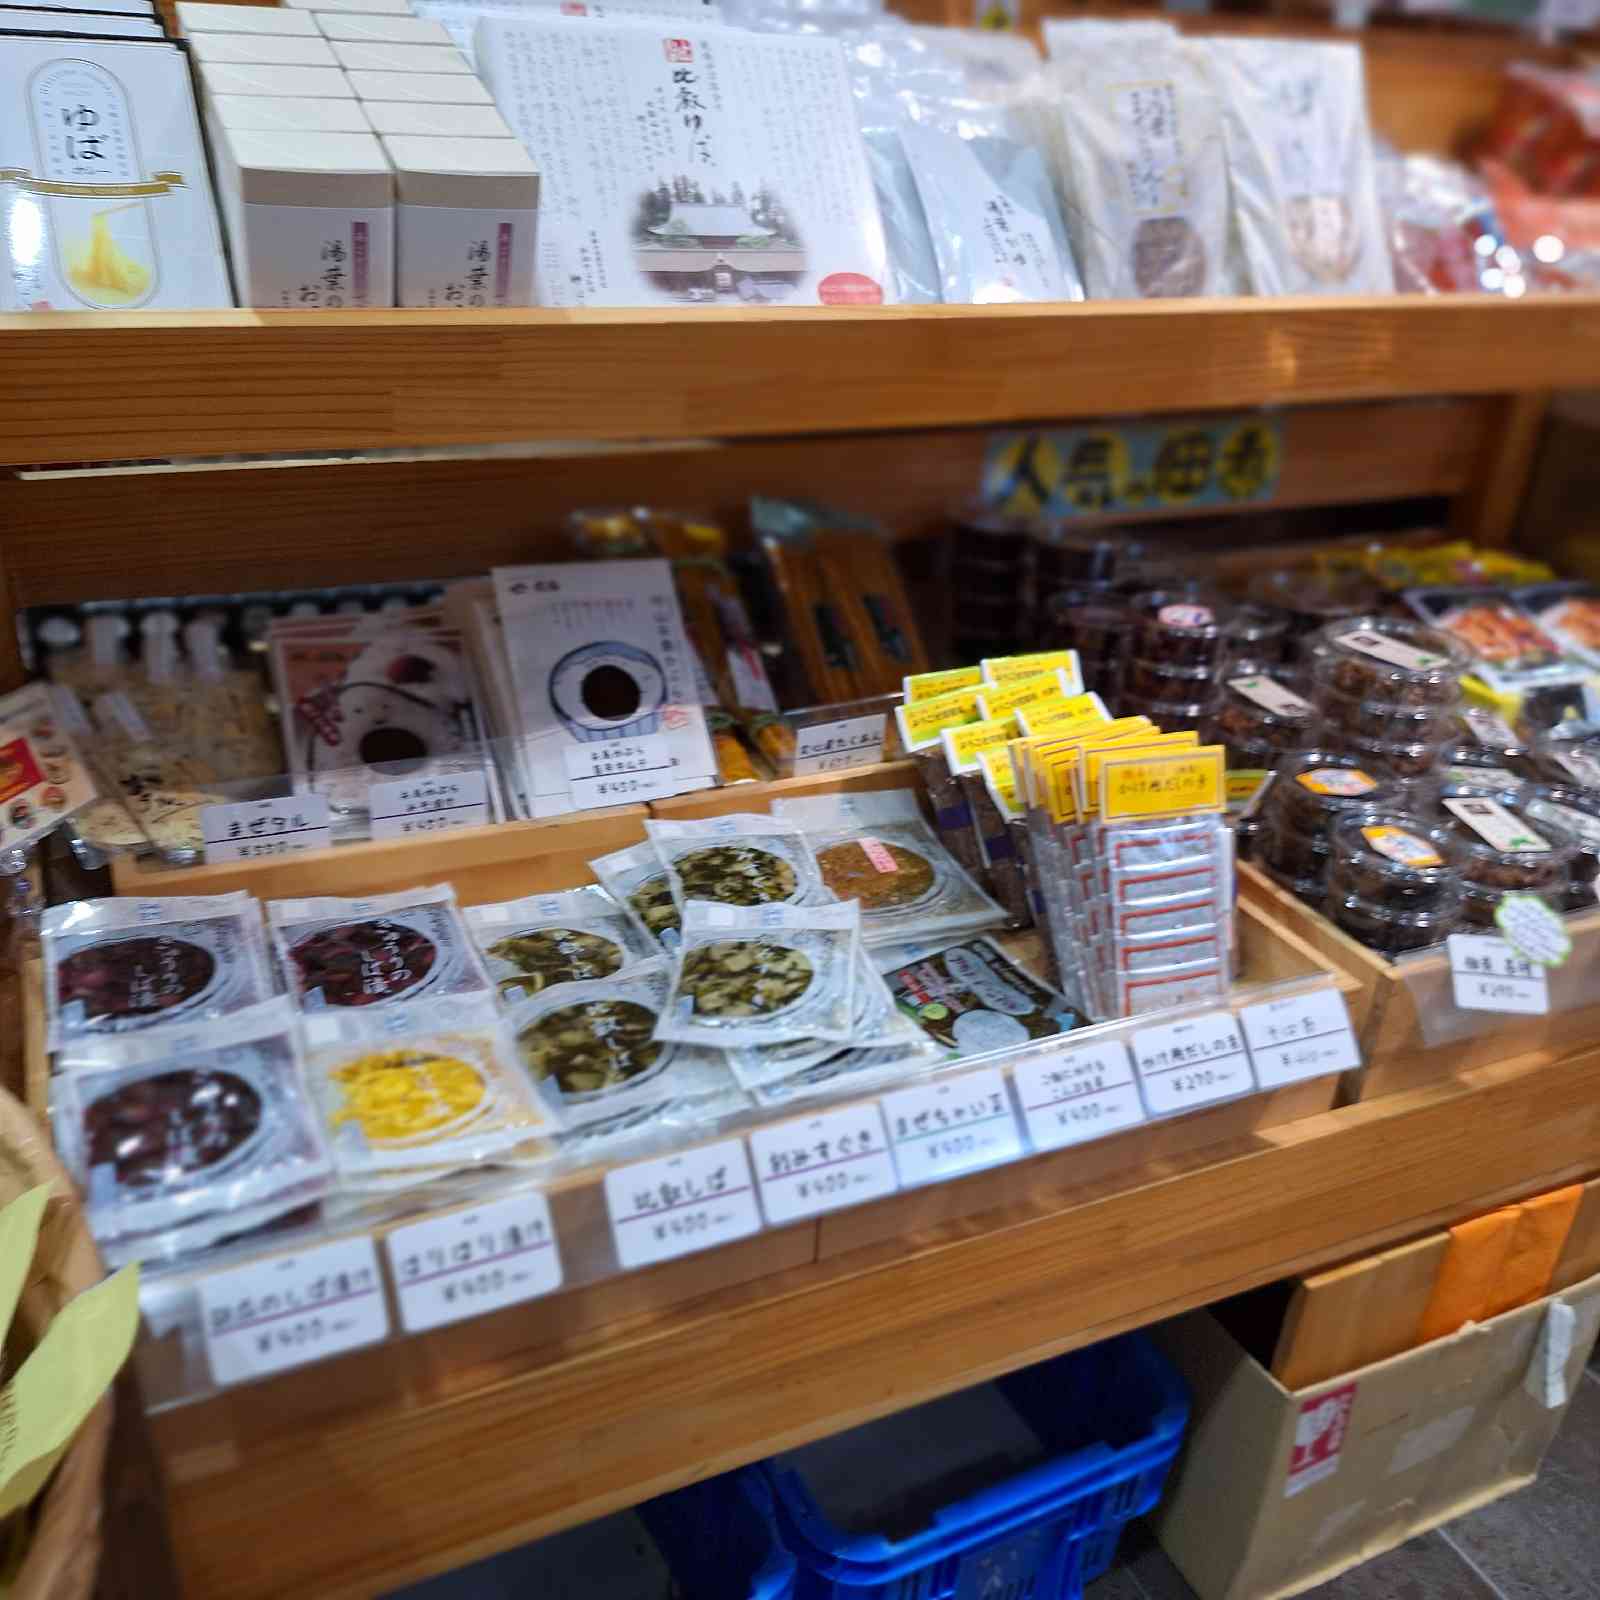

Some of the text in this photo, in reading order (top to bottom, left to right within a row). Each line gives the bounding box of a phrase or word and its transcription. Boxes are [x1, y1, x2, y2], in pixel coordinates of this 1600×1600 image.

[60, 104, 111, 160] ゆば
[633, 1166, 728, 1212] 比叡しば
